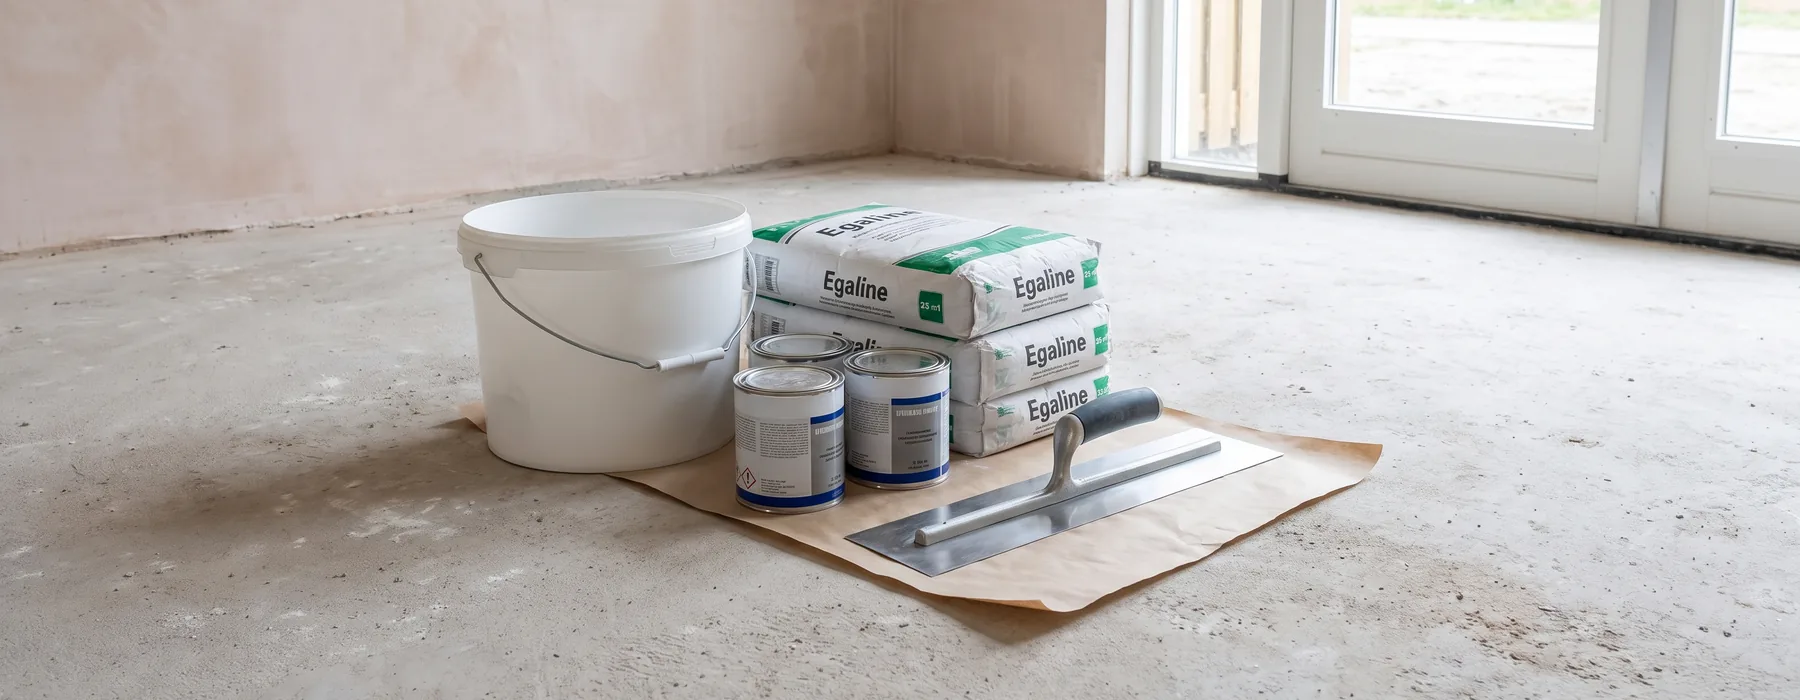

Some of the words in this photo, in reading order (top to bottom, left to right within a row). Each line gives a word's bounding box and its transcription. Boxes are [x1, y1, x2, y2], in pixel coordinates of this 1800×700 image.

[823, 270, 888, 302] Egaline
[1013, 268, 1075, 300] Egaline
[920, 301, 930, 310] 25
[1025, 336, 1087, 368] Egaline
[1027, 387, 1088, 423] Egaline
